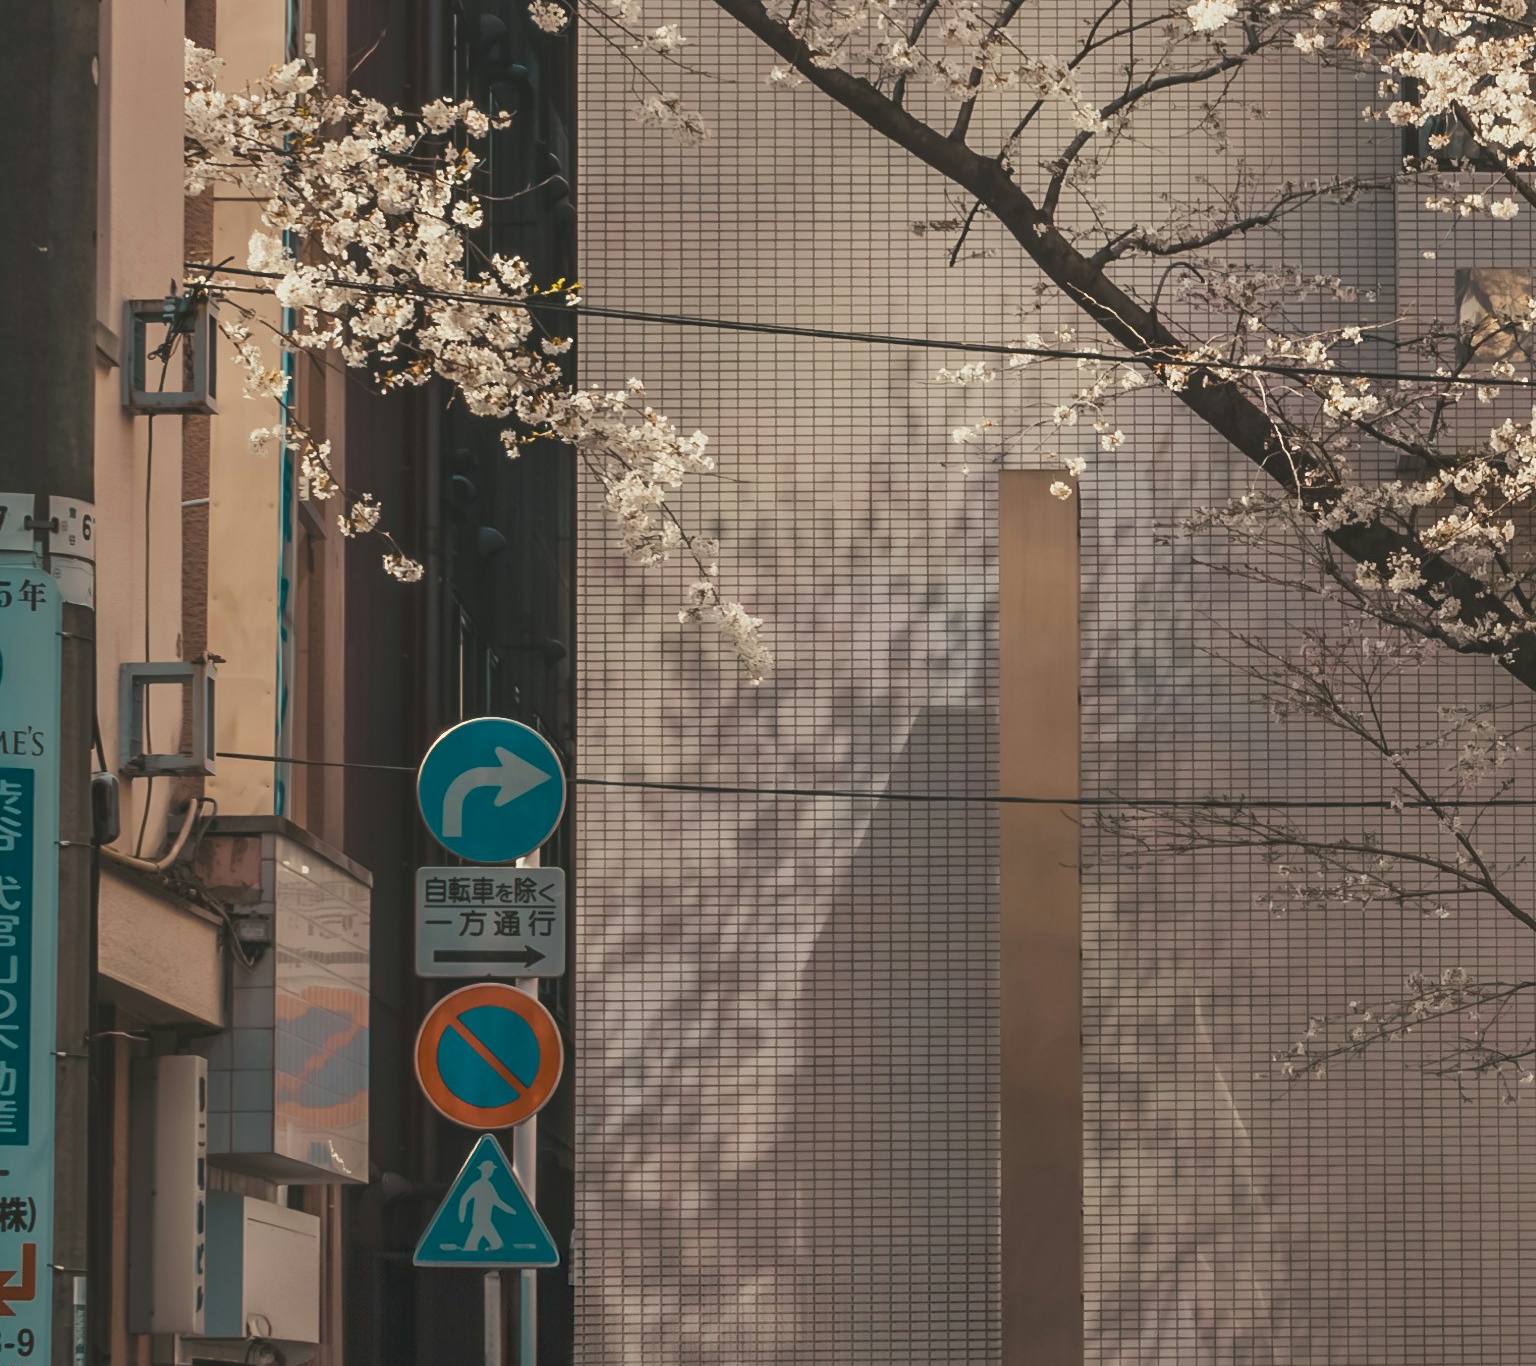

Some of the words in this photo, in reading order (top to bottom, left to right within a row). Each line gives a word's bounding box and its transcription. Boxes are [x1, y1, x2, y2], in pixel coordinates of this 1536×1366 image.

[81, 513, 95, 541] 6
[423, 876, 556, 905] 自転車を除く
[423, 910, 556, 938] 一方通行
